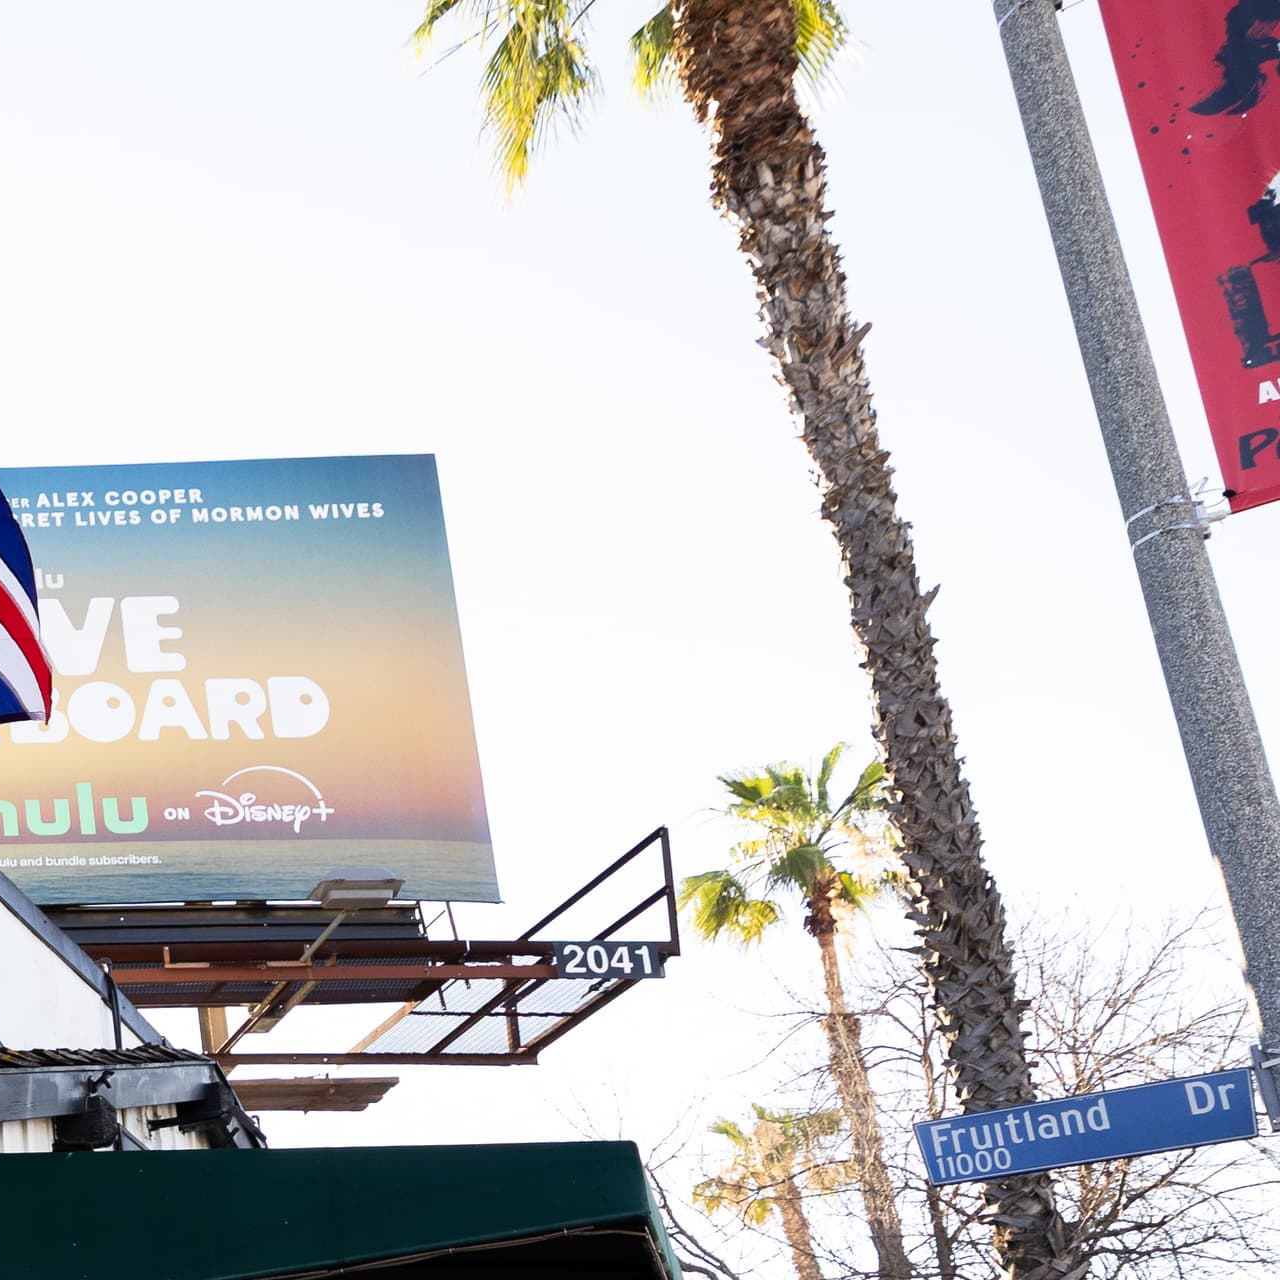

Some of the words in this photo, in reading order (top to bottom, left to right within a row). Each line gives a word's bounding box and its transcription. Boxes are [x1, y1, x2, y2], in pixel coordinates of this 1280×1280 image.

[36, 491, 95, 508] ALEX
[104, 488, 203, 506] COOPER
[75, 509, 141, 526] LIVES
[150, 507, 182, 524] OF
[191, 503, 300, 524] MORMON
[308, 502, 385, 520] WIVES
[164, 806, 190, 821] ON
[20, 855, 43, 867] and
[45, 855, 86, 867] bundle
[89, 853, 162, 866] subscribers.
[562, 944, 653, 975] 2041
[930, 1098, 1111, 1157] Fruitland
[1184, 1081, 1235, 1115] Dr
[935, 1147, 1012, 1179] 11000
